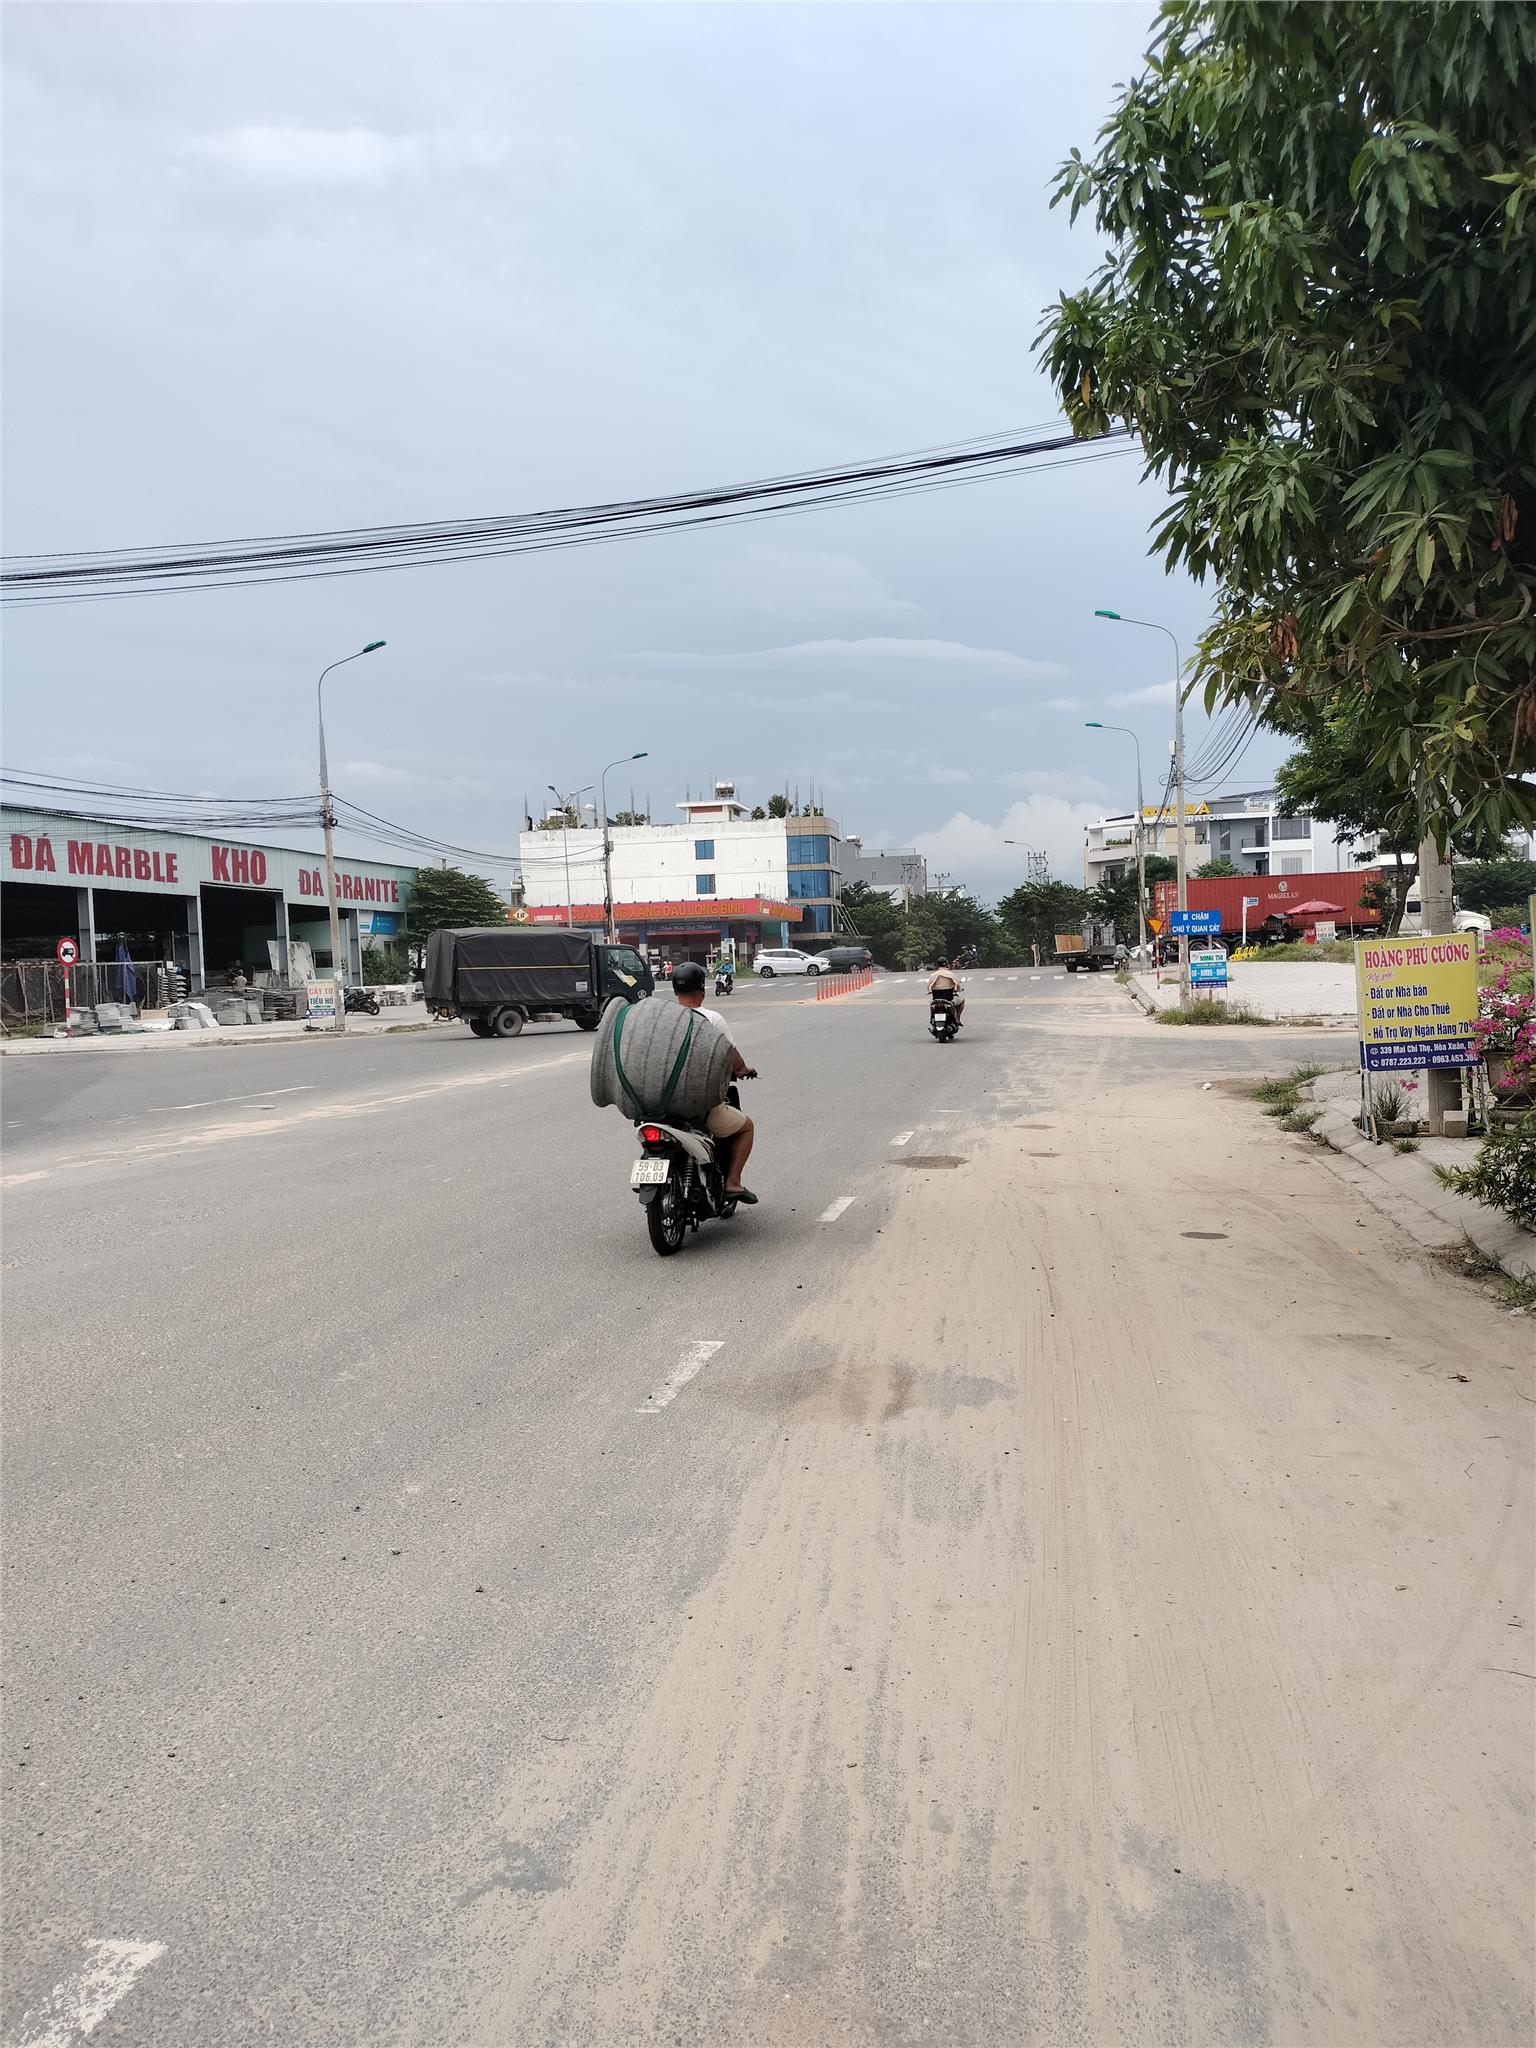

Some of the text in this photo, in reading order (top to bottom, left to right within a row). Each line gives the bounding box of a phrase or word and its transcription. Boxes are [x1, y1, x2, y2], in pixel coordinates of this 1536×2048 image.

[11, 833, 178, 883] ĐÁ MARBLE
[211, 845, 267, 885] KHO
[298, 868, 324, 897] ĐÁ
[1191, 924, 1208, 933] QUAN
[1208, 922, 1220, 932] SÁT
[1364, 940, 1470, 969] HOÀNG PHÚ CƯỜNG
[1370, 984, 1428, 999] Đất or Nhà bán
[1372, 1002, 1450, 1019] Đất or Nhà Cho Thuê
[1385, 1026, 1397, 1040] Trợ
[1399, 1026, 1412, 1039] Vay
[1414, 1023, 1435, 1037] Ngân
[1437, 1023, 1456, 1035] Hàng
[1380, 1057, 1427, 1067] 0787.223.223
